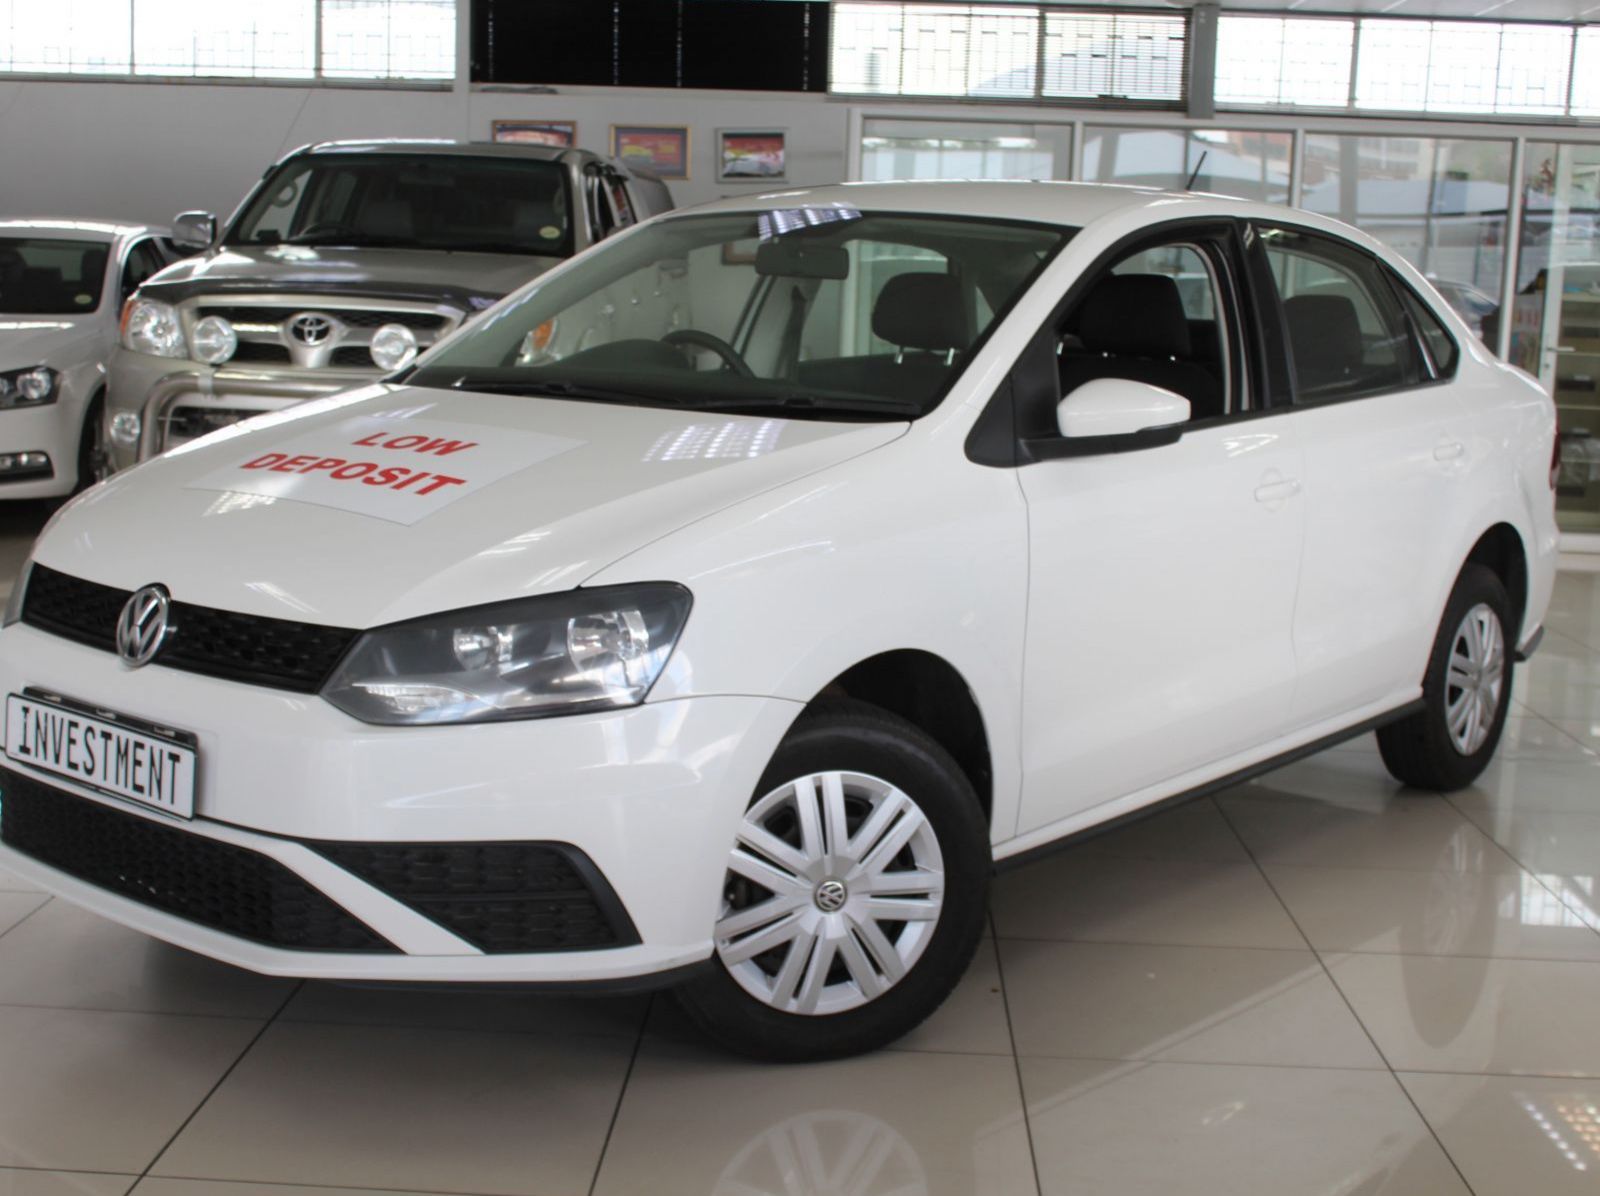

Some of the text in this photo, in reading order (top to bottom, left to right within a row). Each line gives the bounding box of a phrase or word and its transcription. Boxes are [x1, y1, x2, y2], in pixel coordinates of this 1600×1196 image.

[352, 431, 479, 456] LOW
[239, 453, 468, 496] DEPOSIT
[18, 706, 181, 805] INVESTMENT
